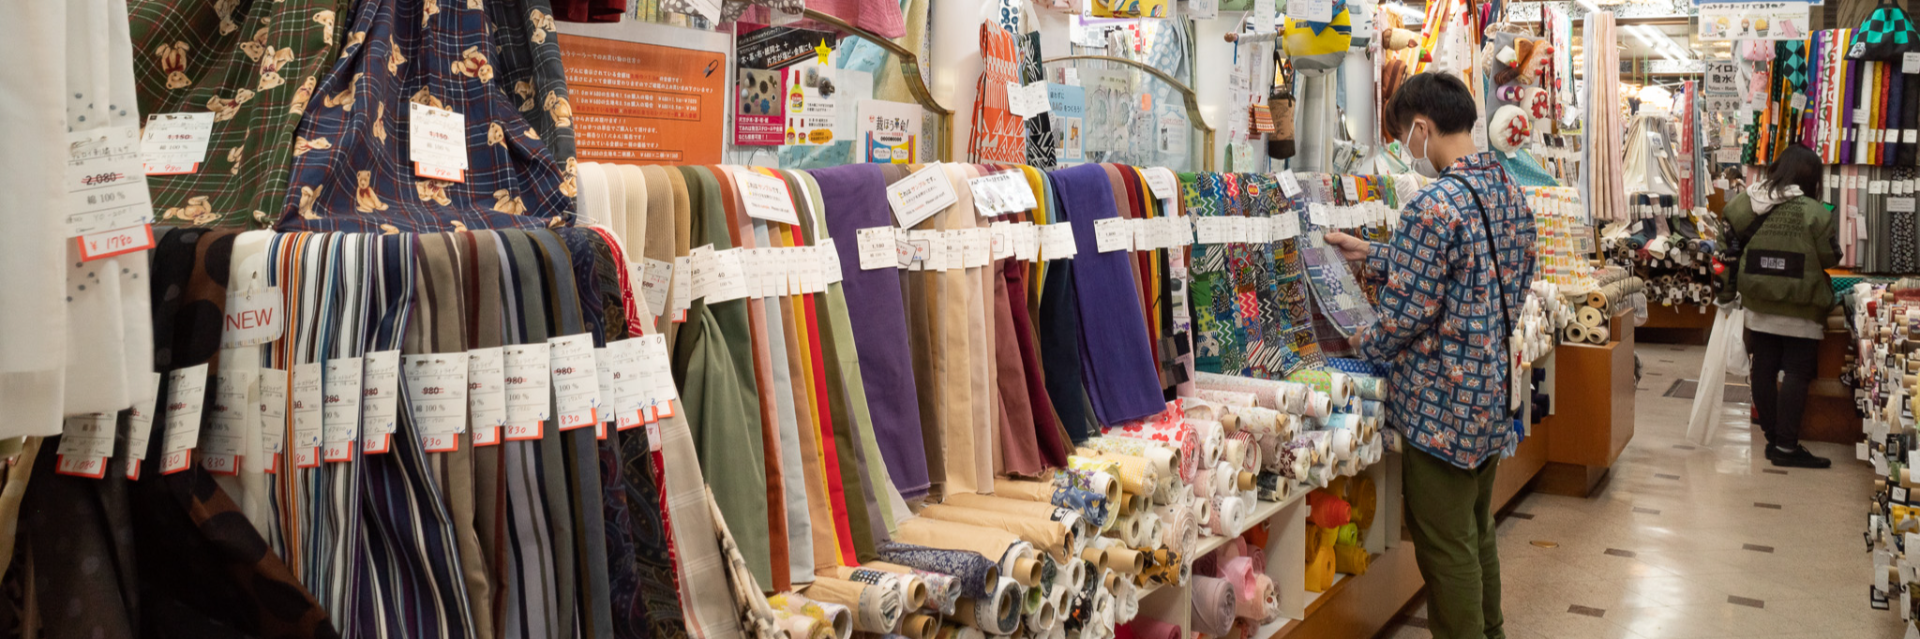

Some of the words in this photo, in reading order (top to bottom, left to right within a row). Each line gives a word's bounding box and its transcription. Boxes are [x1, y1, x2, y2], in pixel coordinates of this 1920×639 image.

[86, 172, 117, 186] 2,080
[101, 193, 115, 203] 100
[117, 191, 126, 200] %
[106, 234, 133, 250] 1780
[226, 307, 273, 331] NEW
[557, 367, 572, 375] 980
[507, 377, 523, 385] 980
[423, 387, 439, 395] 980
[561, 415, 579, 424] 830
[508, 426, 526, 434] 830
[423, 438, 441, 448] 830
[162, 453, 179, 466] 830
[207, 457, 225, 468] 830
